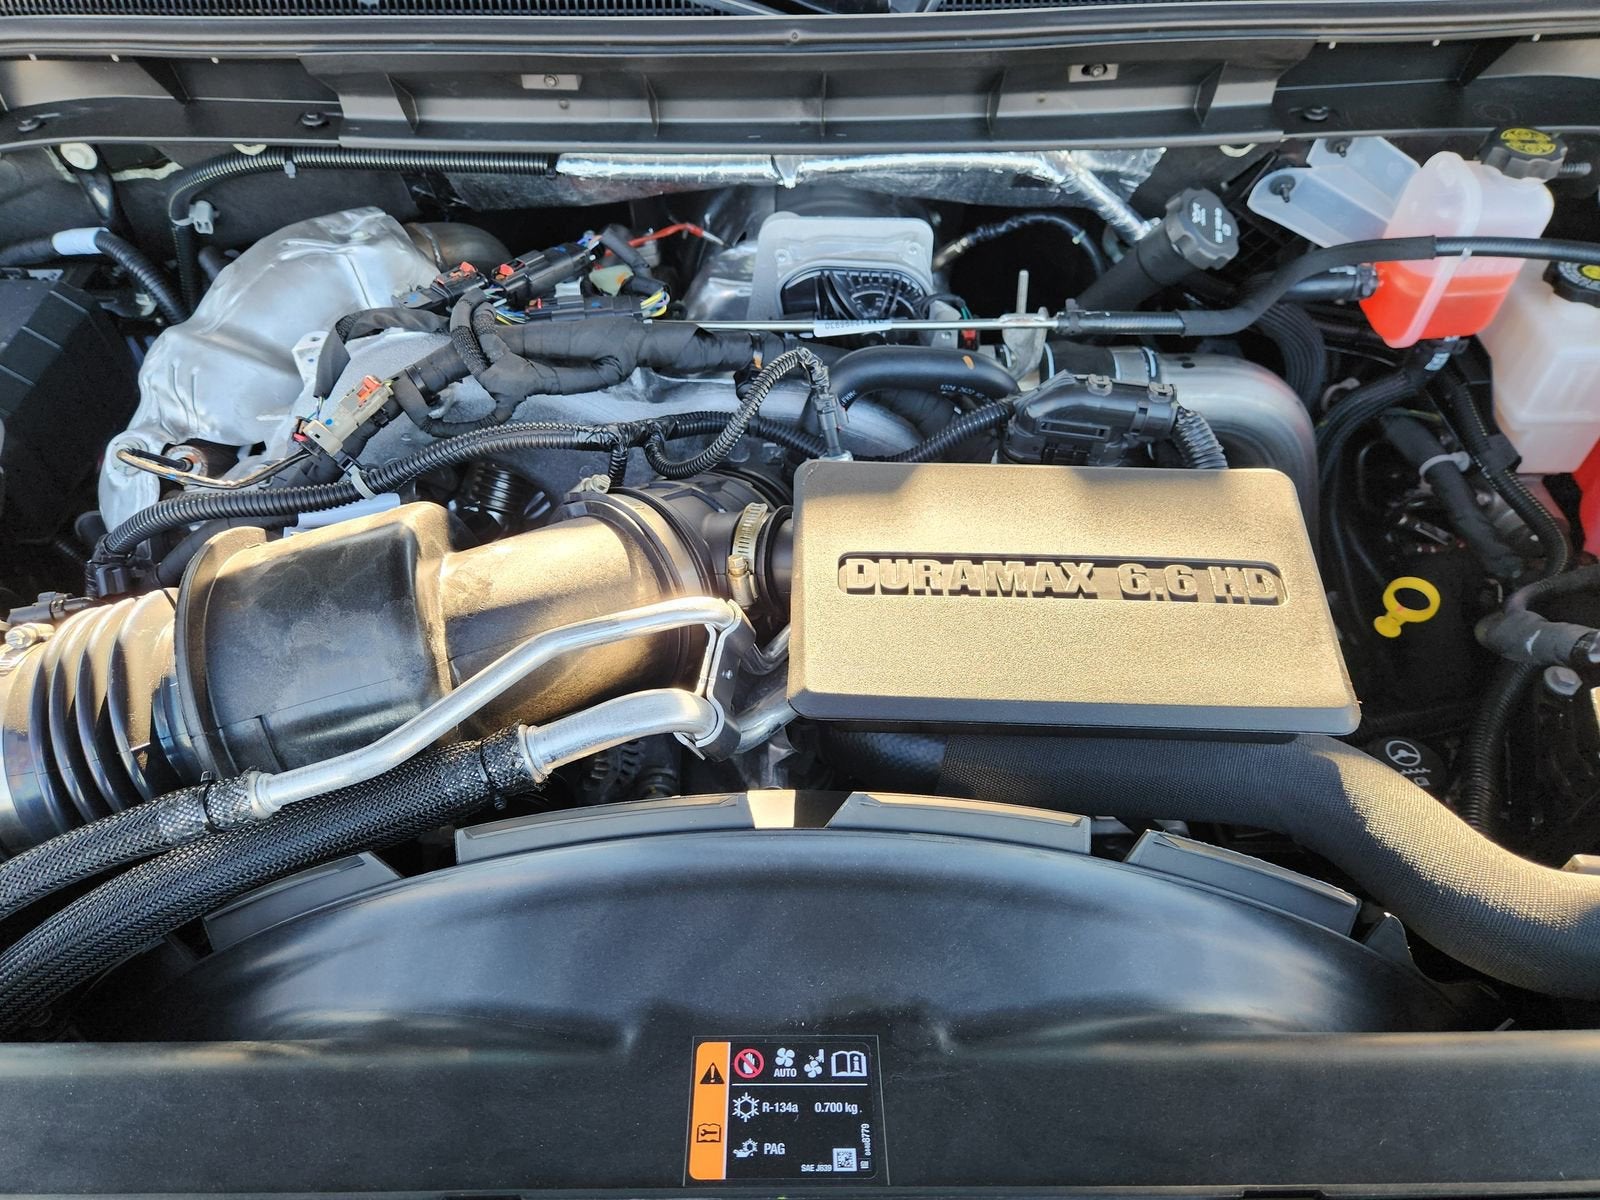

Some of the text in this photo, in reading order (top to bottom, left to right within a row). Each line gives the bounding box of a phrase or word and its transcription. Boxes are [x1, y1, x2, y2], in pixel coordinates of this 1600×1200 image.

[846, 558, 1278, 603] DURAMAX 6.6 HD
[774, 1068, 797, 1078] AUTO
[762, 1102, 799, 1113] R-134a
[815, 1102, 842, 1113] 0.700
[763, 1143, 785, 1155] PAG
[801, 1164, 815, 1172] SAE
